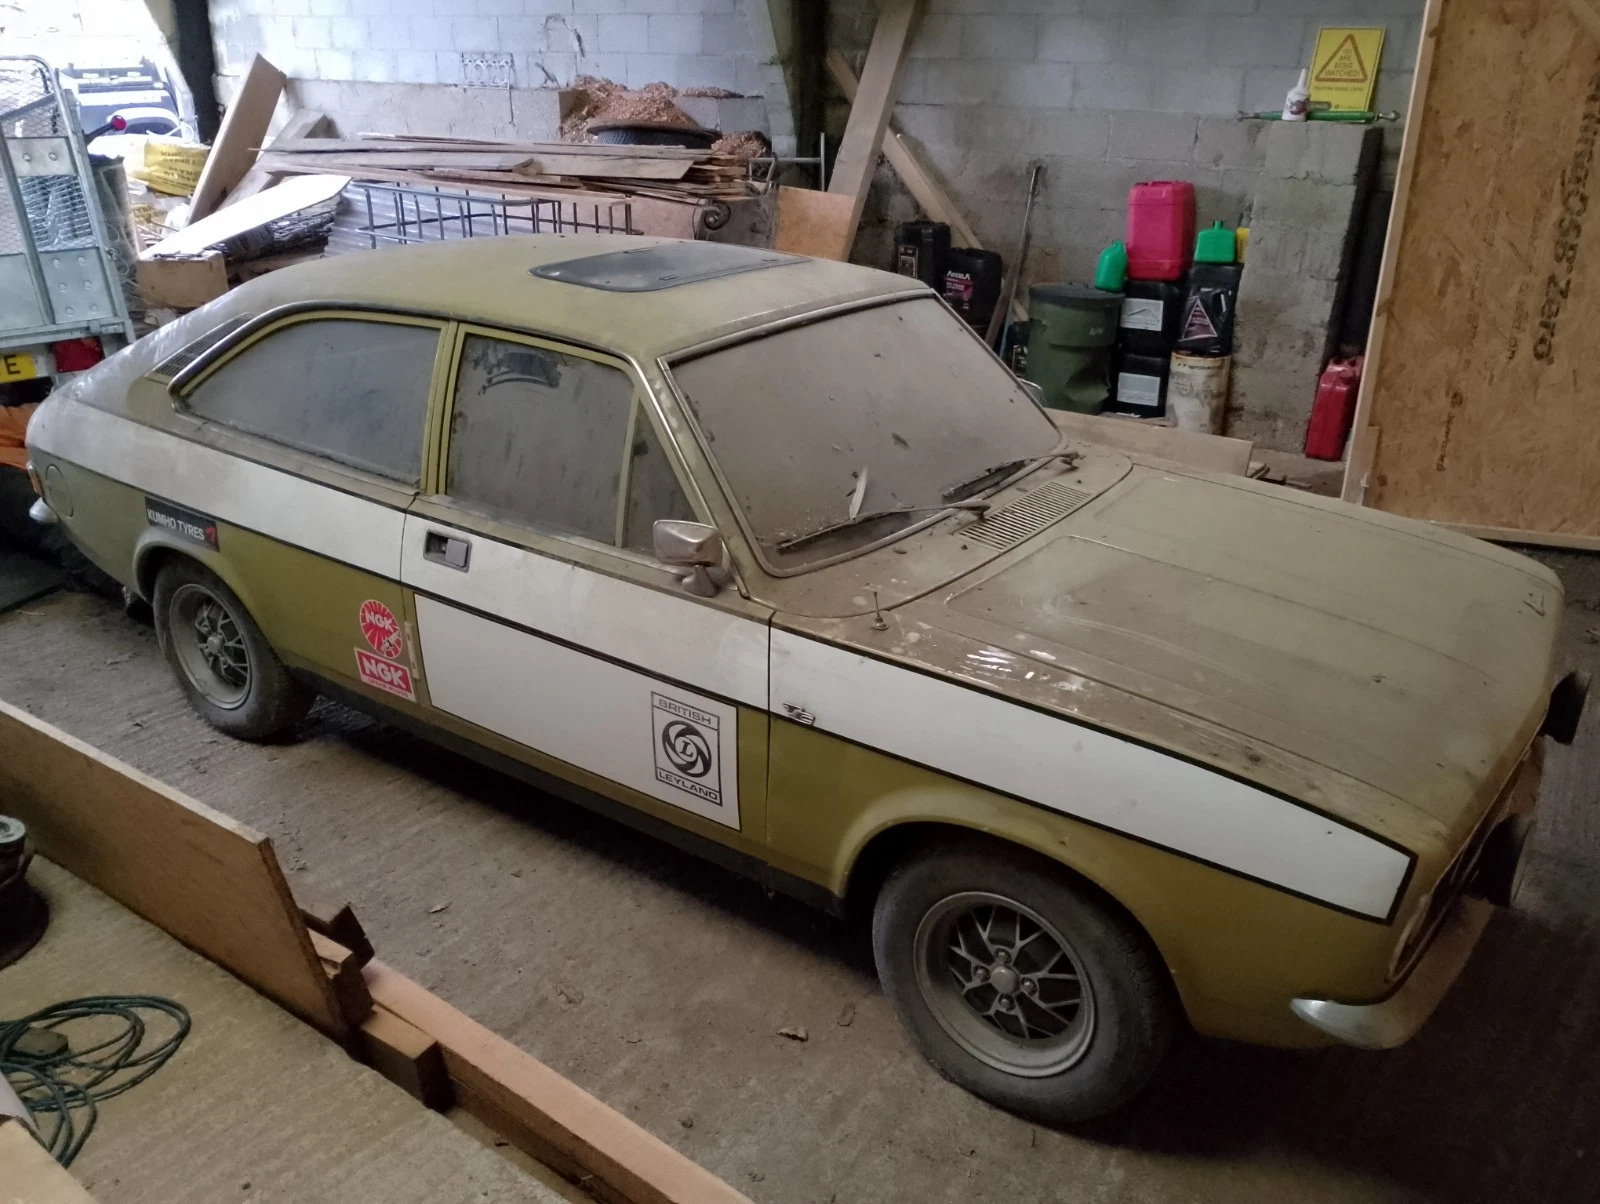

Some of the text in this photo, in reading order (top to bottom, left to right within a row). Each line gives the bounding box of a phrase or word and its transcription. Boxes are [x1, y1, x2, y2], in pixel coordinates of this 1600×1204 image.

[147, 508, 205, 541] KUMHO TYRES
[364, 608, 394, 633] NGK
[362, 656, 407, 689] NGK
[658, 698, 712, 725] BRITISH
[679, 740, 694, 758] L
[659, 771, 718, 801] LEYLAND
